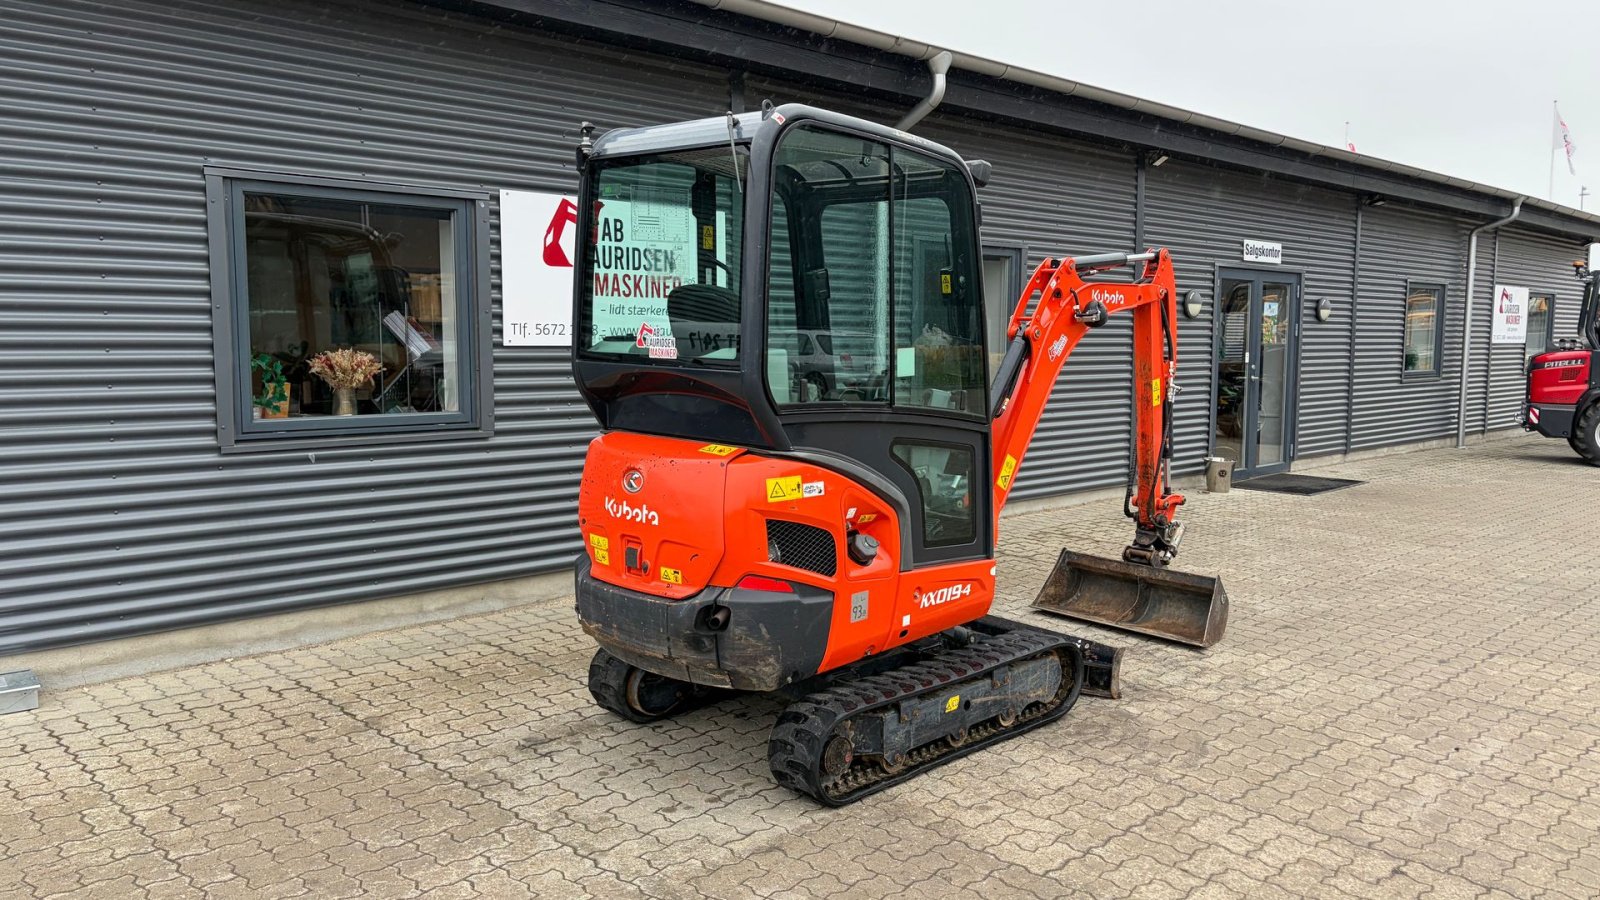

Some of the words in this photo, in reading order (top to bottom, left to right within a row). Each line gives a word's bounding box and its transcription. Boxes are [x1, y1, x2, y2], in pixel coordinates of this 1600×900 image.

[602, 217, 624, 242] AB
[593, 245, 675, 273] AURIDSEN
[1245, 243, 1281, 259] Salgskontor
[1091, 288, 1125, 305] Kubota
[609, 304, 625, 316] lidt
[511, 323, 531, 339] Tlf.
[535, 323, 566, 336] 5672
[646, 336, 675, 348] LAURIDSEN
[649, 347, 677, 357] MASKINER
[1544, 359, 1584, 369] PITBULL
[605, 496, 659, 526] Kubota
[919, 583, 972, 609] KX019-4
